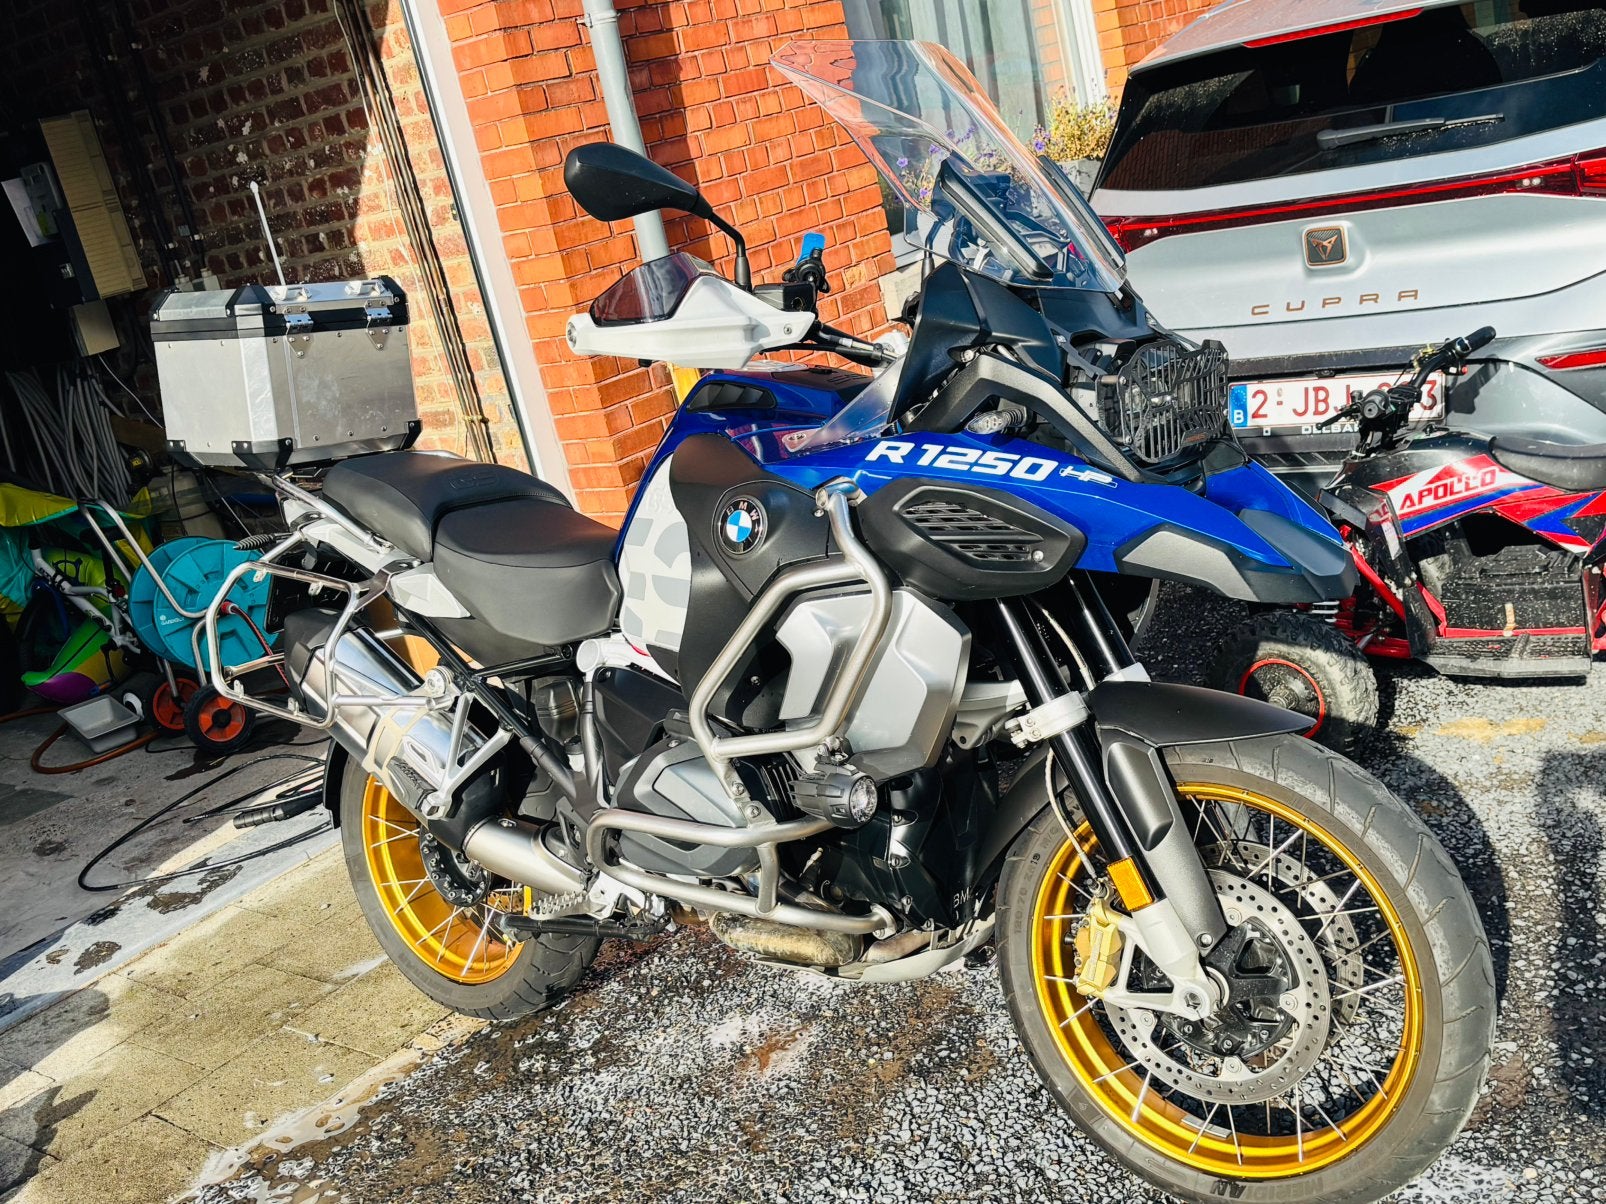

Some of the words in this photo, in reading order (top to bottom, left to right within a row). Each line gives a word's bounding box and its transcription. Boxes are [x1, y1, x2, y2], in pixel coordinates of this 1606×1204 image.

[1251, 289, 1419, 316] CUPRA
[1233, 409, 1244, 424] B
[865, 440, 916, 465] R
[917, 443, 1059, 482] 1250
[1400, 469, 1498, 511] APOLLO
[725, 500, 760, 521] BMW
[1210, 1178, 1324, 1199] MERIDIAN
